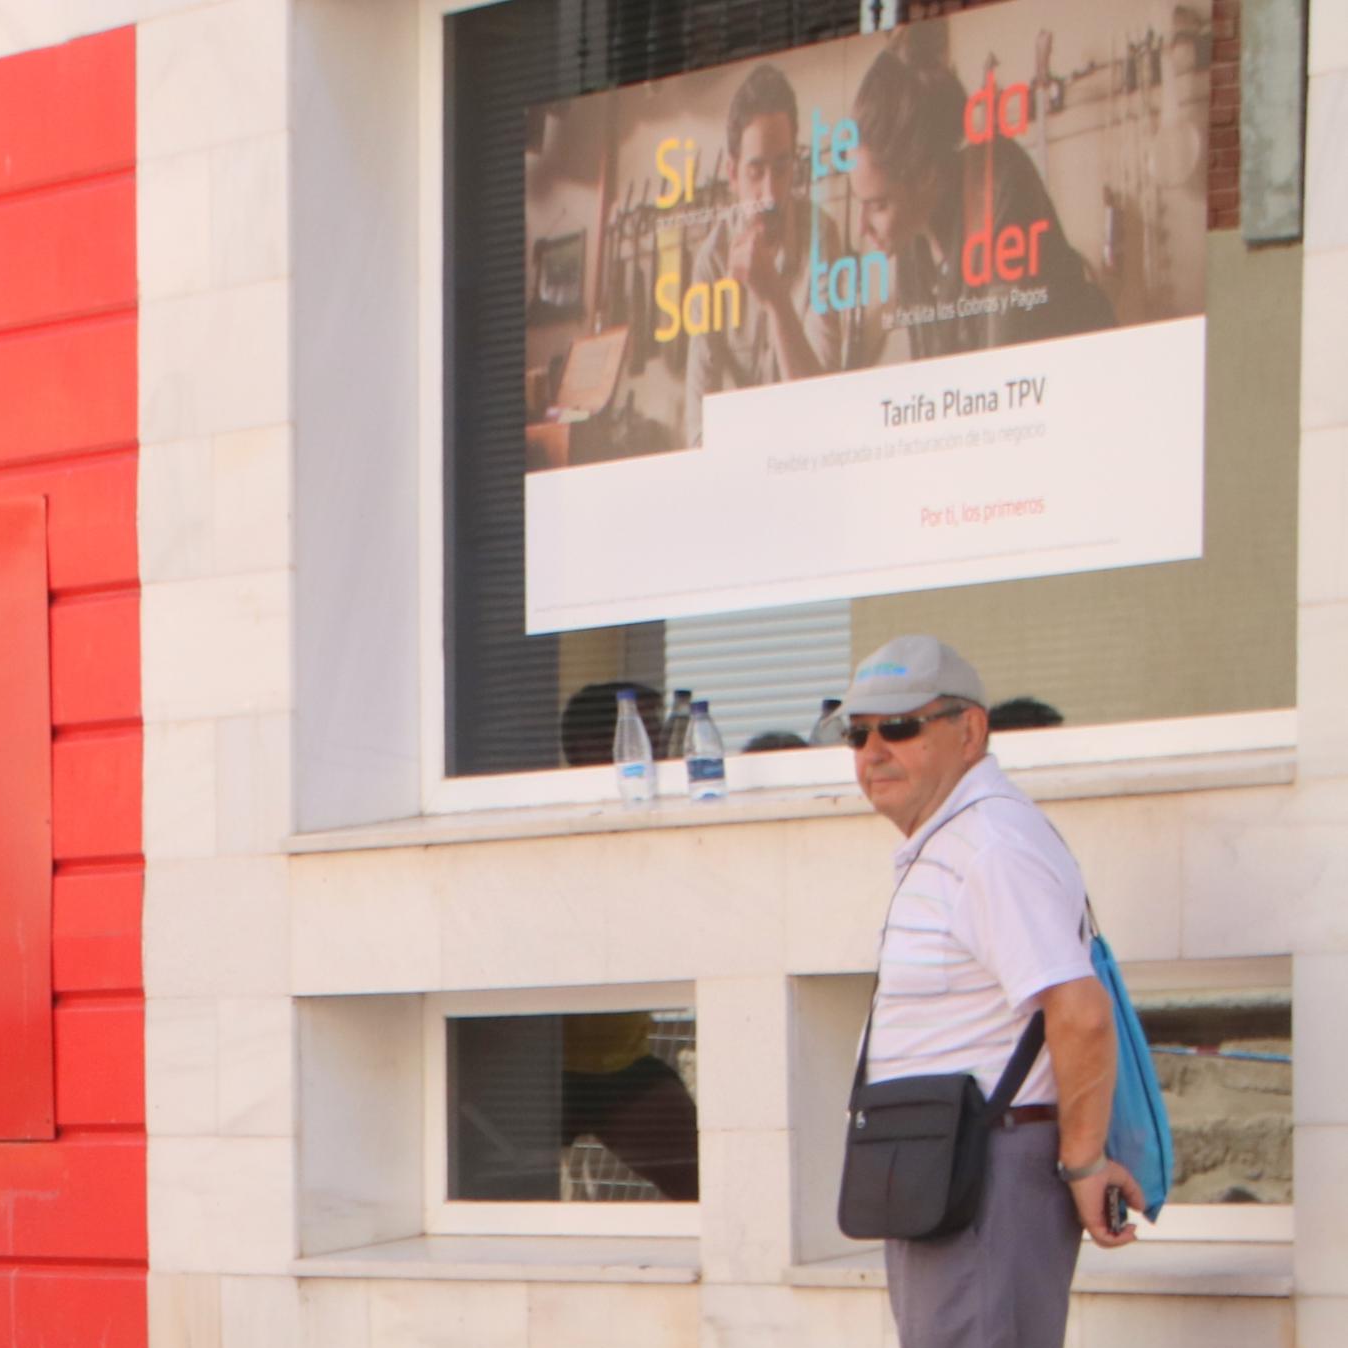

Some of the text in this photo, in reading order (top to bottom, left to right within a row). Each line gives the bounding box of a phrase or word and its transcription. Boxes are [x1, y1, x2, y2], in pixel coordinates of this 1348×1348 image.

[655, 68, 1031, 208] Si te da
[654, 215, 1050, 342] San tan der
[1010, 287, 1049, 311] Pagos
[881, 376, 1046, 428] Tarifa Plana TPV
[920, 506, 944, 528] Por
[962, 501, 982, 523] los
[984, 497, 1046, 526] primeros
